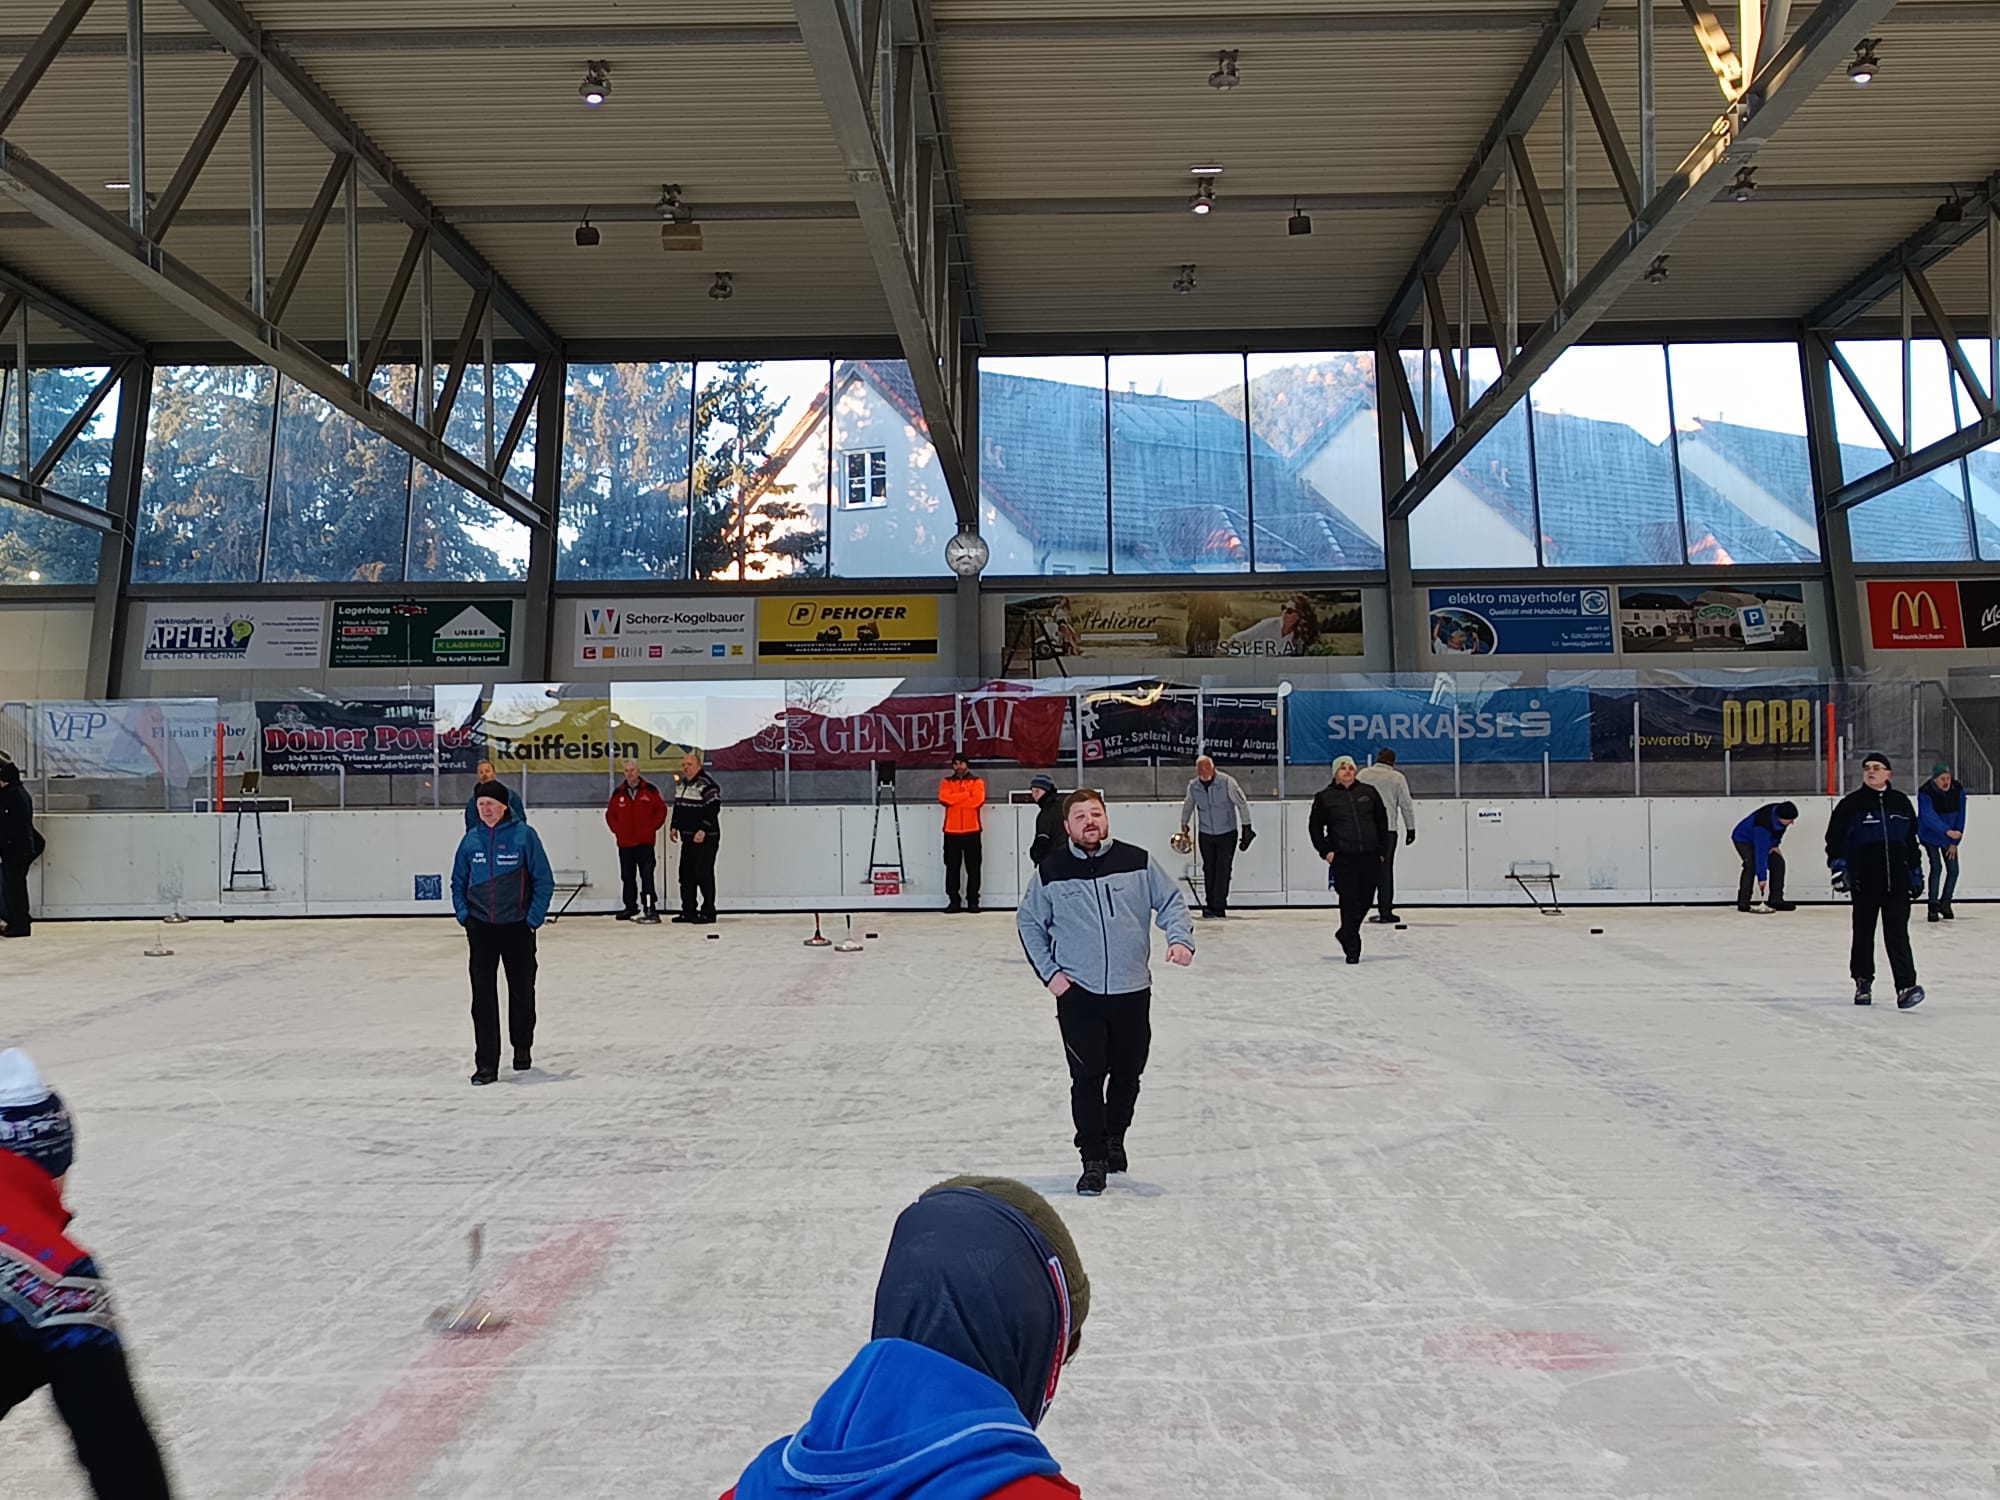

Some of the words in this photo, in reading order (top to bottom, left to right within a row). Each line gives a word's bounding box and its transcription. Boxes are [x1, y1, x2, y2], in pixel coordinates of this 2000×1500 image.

[1448, 592, 1495, 605] elektro
[1498, 590, 1577, 607] mayerhofer
[338, 606, 391, 616] Lagerhaus
[625, 612, 745, 625] Scherz-Kogelbauer
[820, 606, 907, 620] PEHOFER
[1082, 608, 1157, 630] Italiener
[1489, 607, 1520, 616] Qualität
[1520, 607, 1533, 615] mit
[1534, 607, 1578, 616] Handschlag
[153, 616, 214, 626] elektroapfler.at
[147, 625, 228, 648] APFLER
[1892, 633, 1945, 641] Neunkirchen
[446, 641, 501, 649] LAGERHAUS
[1193, 639, 1305, 656] KESSLER.AT
[144, 652, 194, 661] ELEKTRO
[197, 651, 246, 660] TECHNIK
[48, 711, 108, 742] VFP
[819, 698, 1018, 754] GENERALI
[1327, 712, 1514, 740] SPARKASSE
[263, 726, 368, 753] Dobler
[373, 725, 473, 751] Power
[1103, 735, 1123, 750] KFZ
[1242, 736, 1278, 751] Airbrus
[1693, 732, 1713, 749] by
[497, 734, 640, 761] Raiffeisen
[342, 753, 378, 762] Triester
